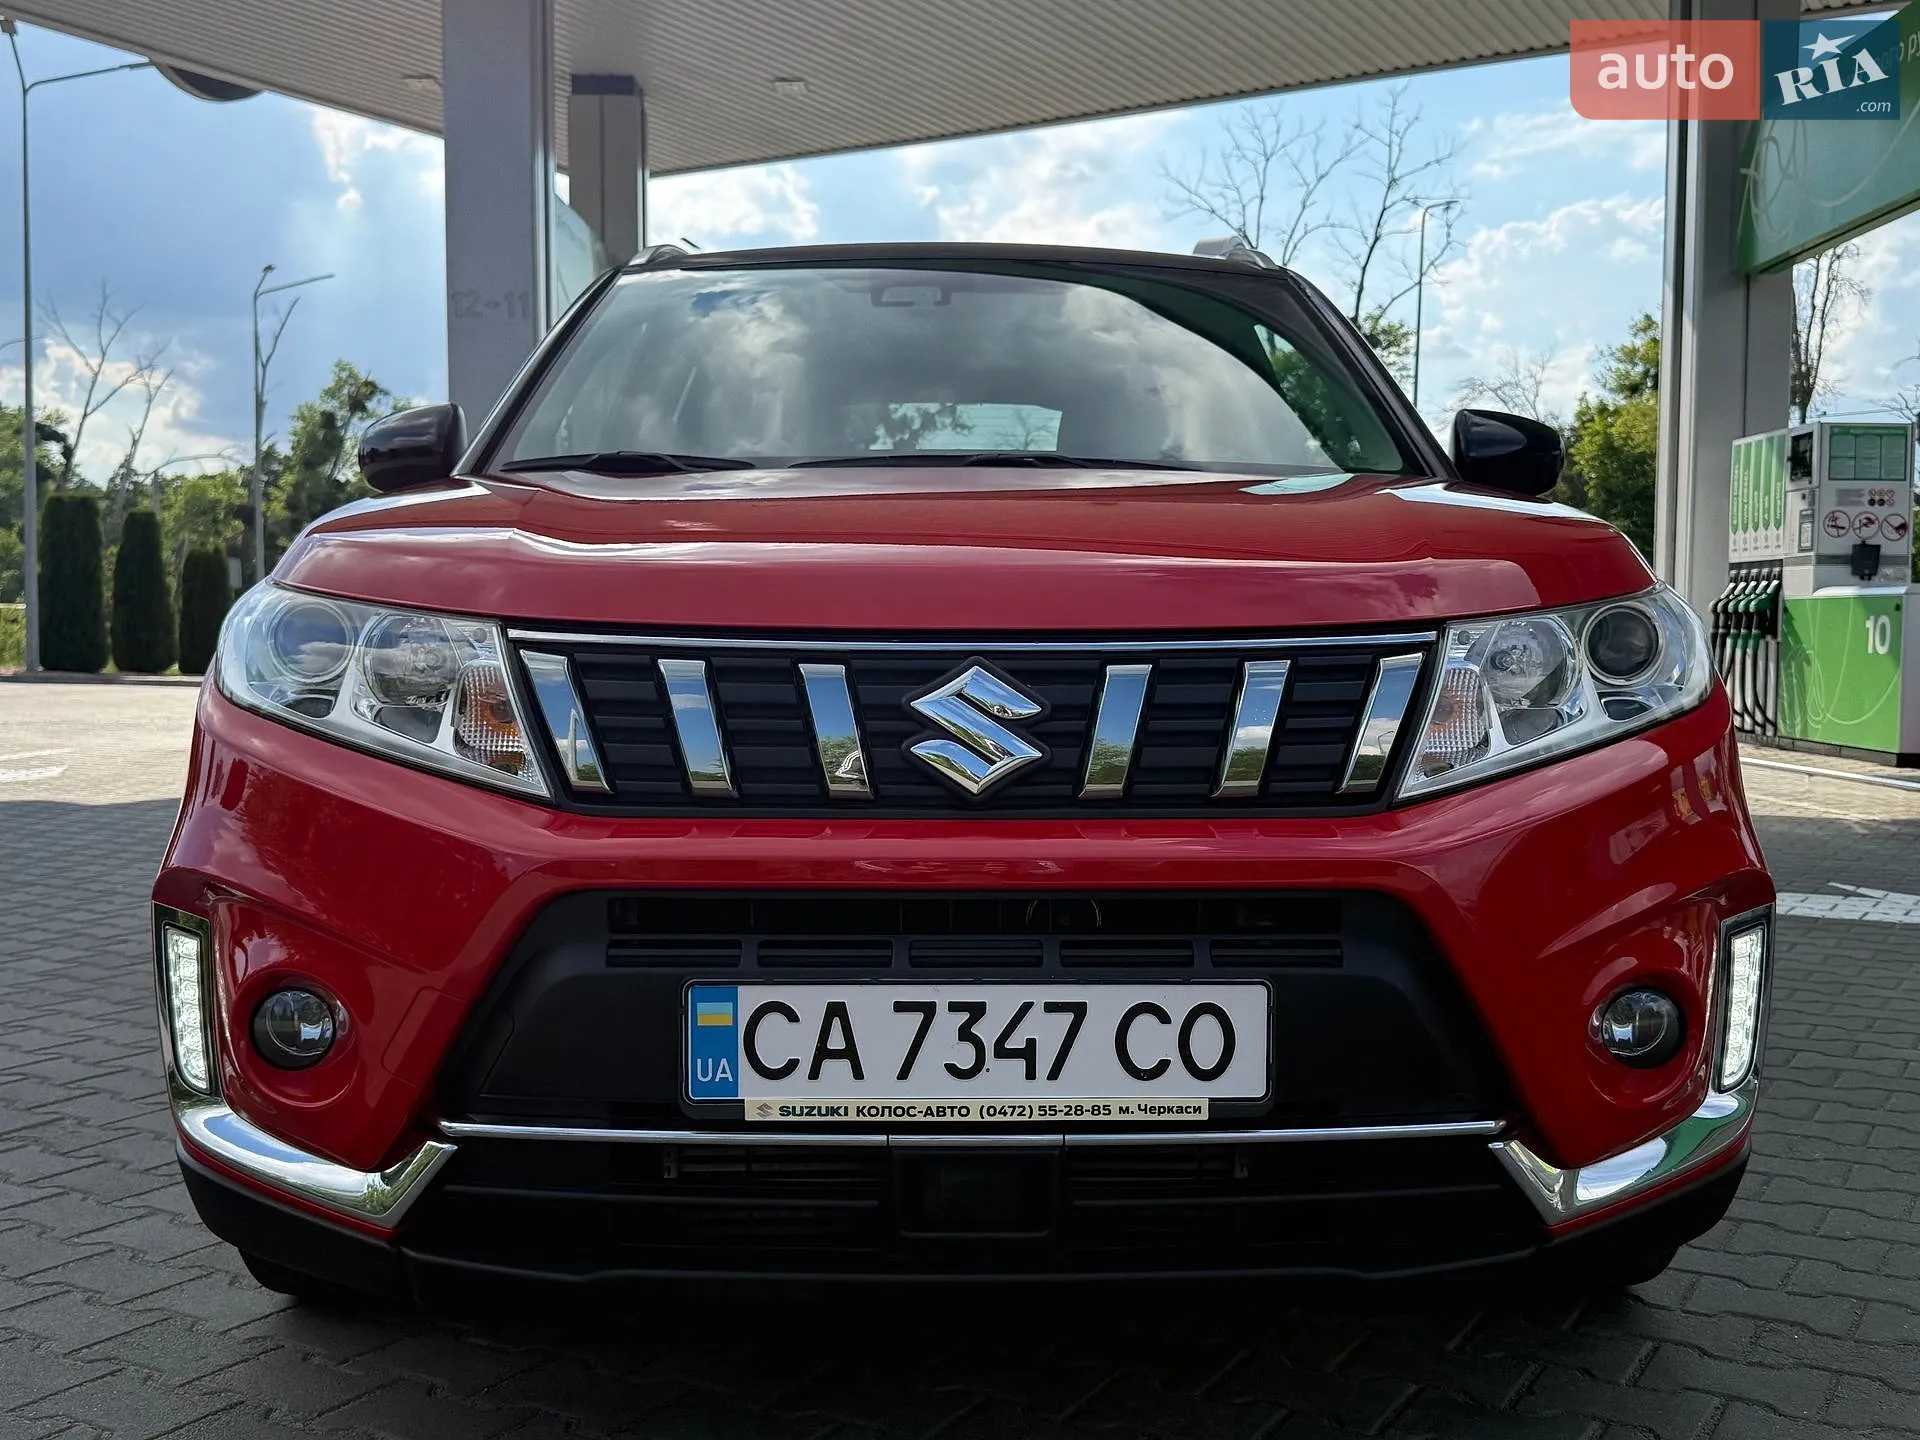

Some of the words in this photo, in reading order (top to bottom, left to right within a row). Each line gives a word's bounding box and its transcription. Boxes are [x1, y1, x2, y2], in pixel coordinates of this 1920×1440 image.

[1865, 615, 1891, 655] 10
[743, 1001, 866, 1081] CA
[892, 1001, 1088, 1081] 7347
[1114, 1001, 1237, 1082] CO
[697, 1058, 734, 1083] UA
[778, 1105, 849, 1117] SUZUKI
[855, 1105, 971, 1118] КОЛОС-АВТО
[978, 1104, 1034, 1119] (0472)
[1037, 1104, 1112, 1117] 55-28-85
[1118, 1105, 1135, 1116] м.
[1137, 1103, 1203, 1116] Черкаси
